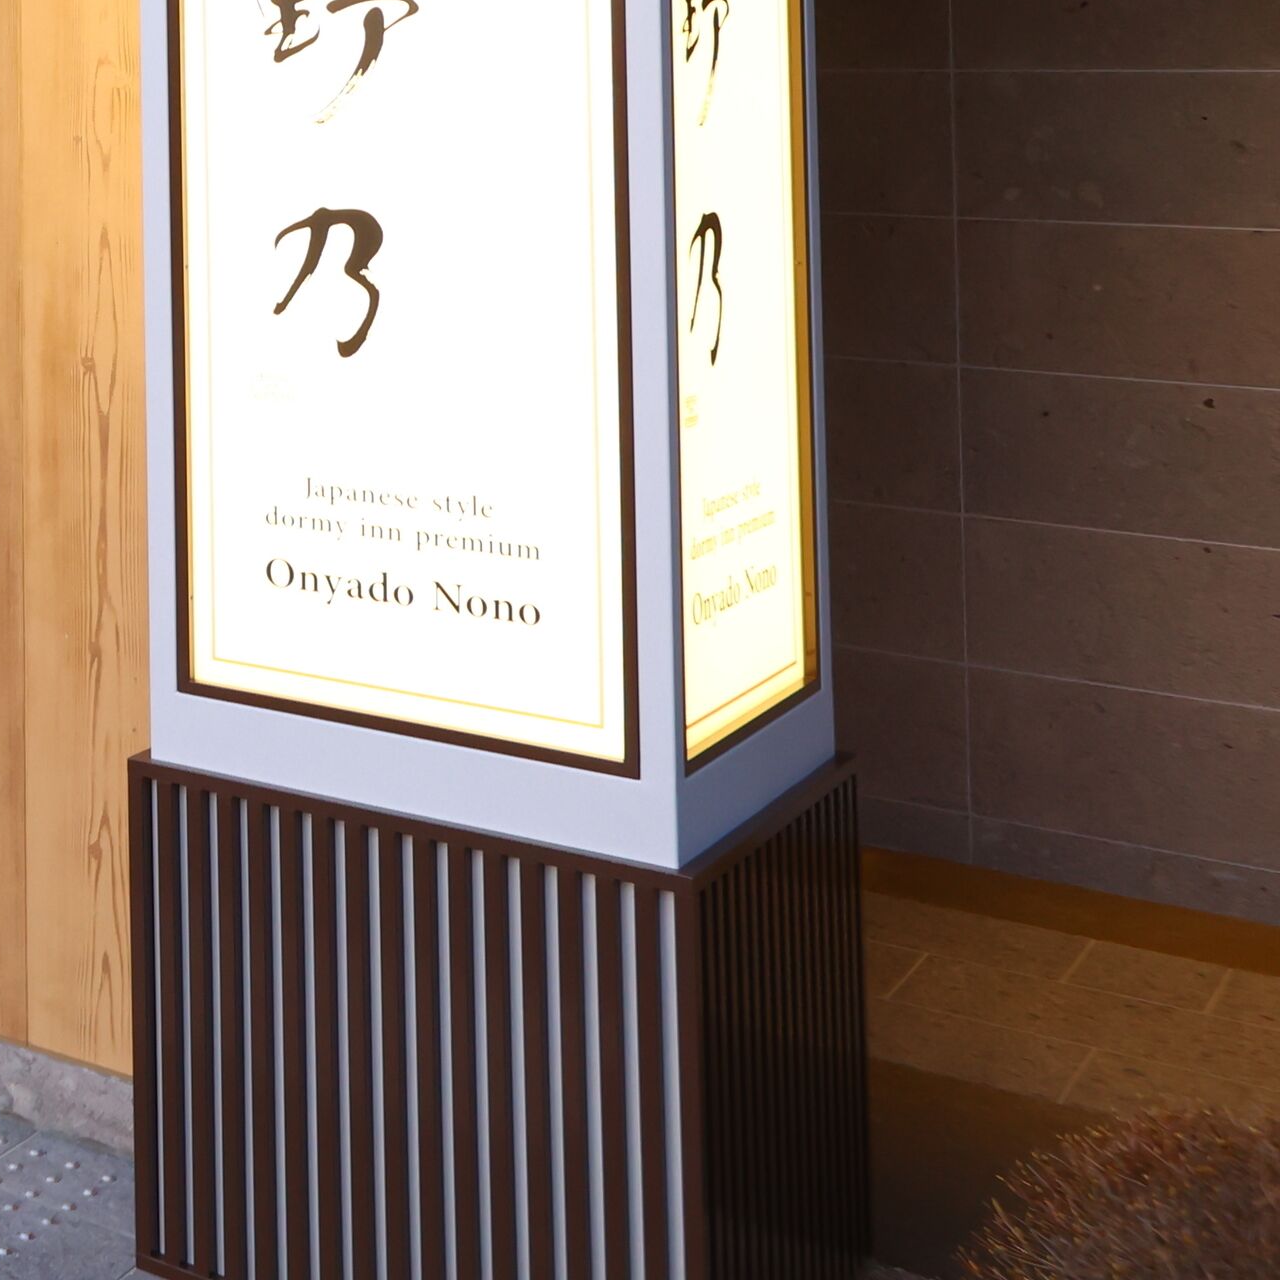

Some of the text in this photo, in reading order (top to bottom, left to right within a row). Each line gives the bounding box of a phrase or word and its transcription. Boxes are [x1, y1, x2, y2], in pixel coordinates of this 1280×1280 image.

[305, 476, 494, 523] Japanese style
[265, 504, 541, 561] dormy inn premium
[265, 557, 541, 626] Onyado Nono
